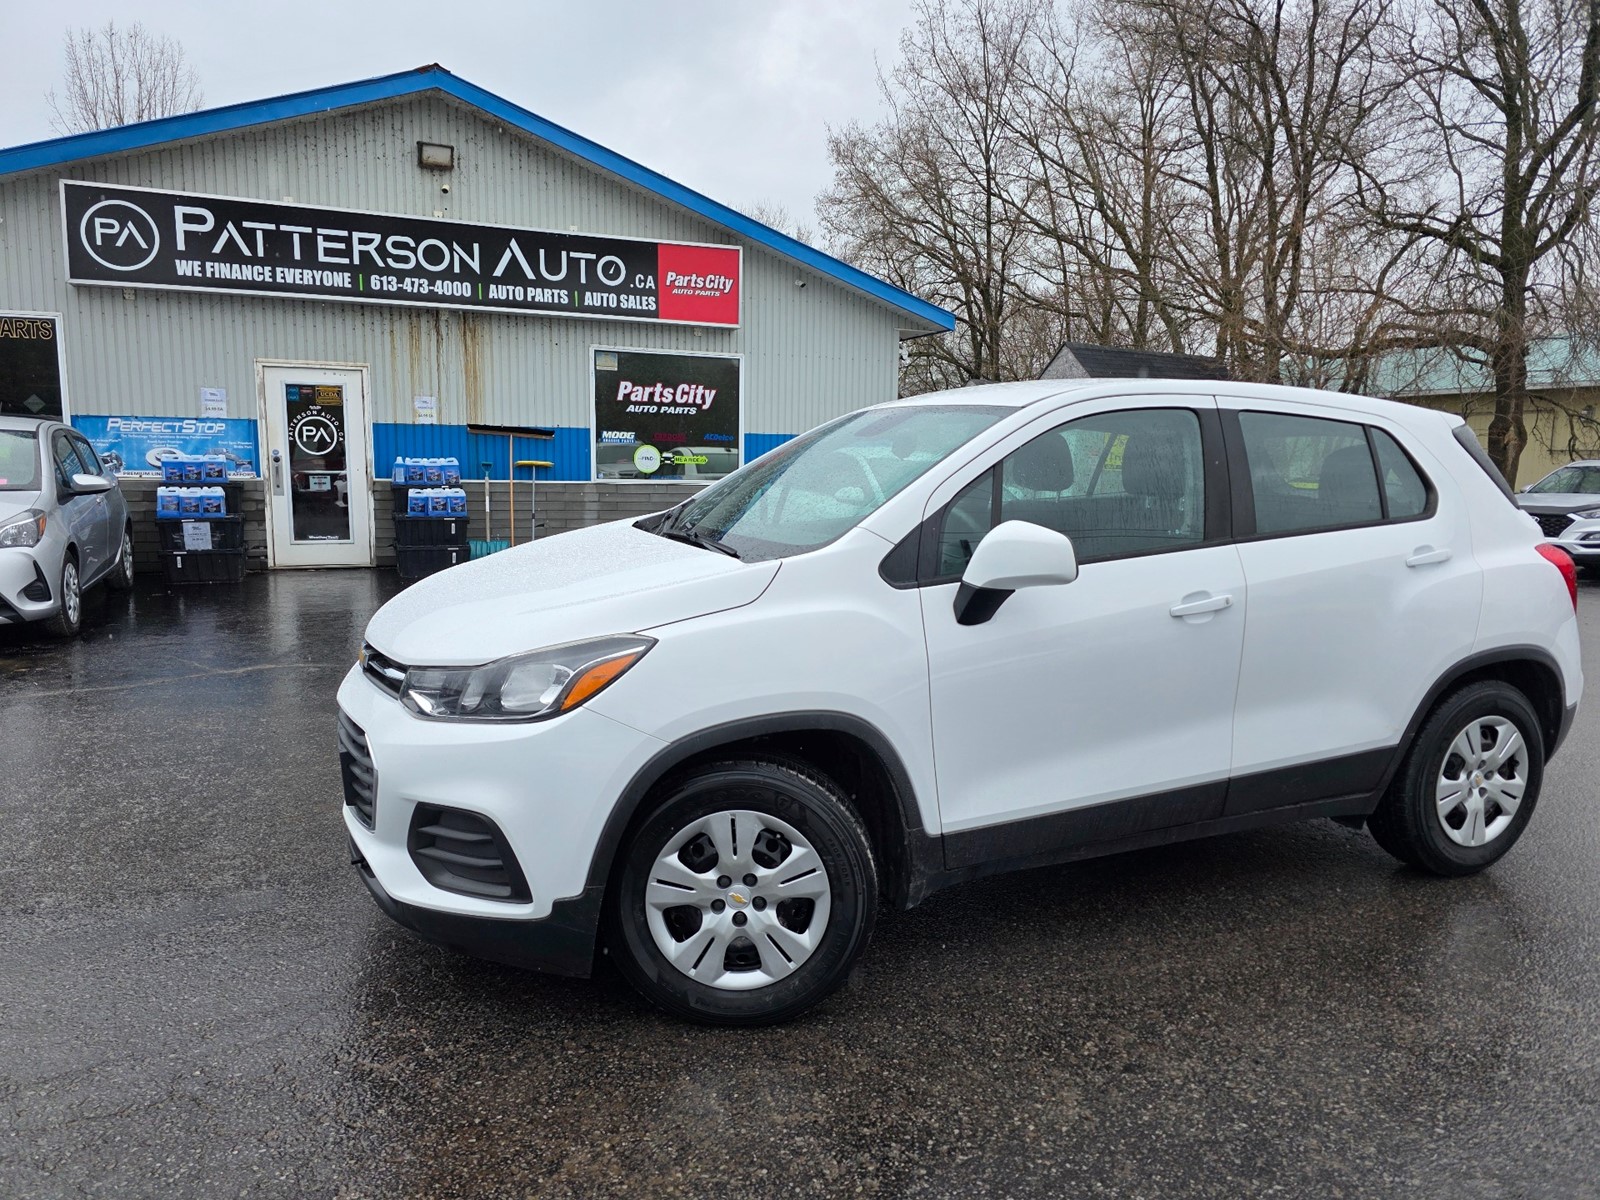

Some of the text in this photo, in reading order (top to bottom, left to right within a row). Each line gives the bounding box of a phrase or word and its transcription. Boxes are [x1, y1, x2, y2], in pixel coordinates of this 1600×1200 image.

[173, 205, 481, 275] PATTERSON
[492, 237, 626, 287] AUTO
[175, 259, 656, 311] WE FINANCE EVERYONE 613-473-4000 AUTO PARTS AUTO SALES
[672, 287, 720, 297] AUTO PARTS
[626, 404, 697, 415] AUTO PARTS
[288, 410, 318, 441] PATTERSON
[320, 411, 340, 426] AUTO
[302, 426, 332, 443] PA
[602, 430, 636, 439] MOOG
